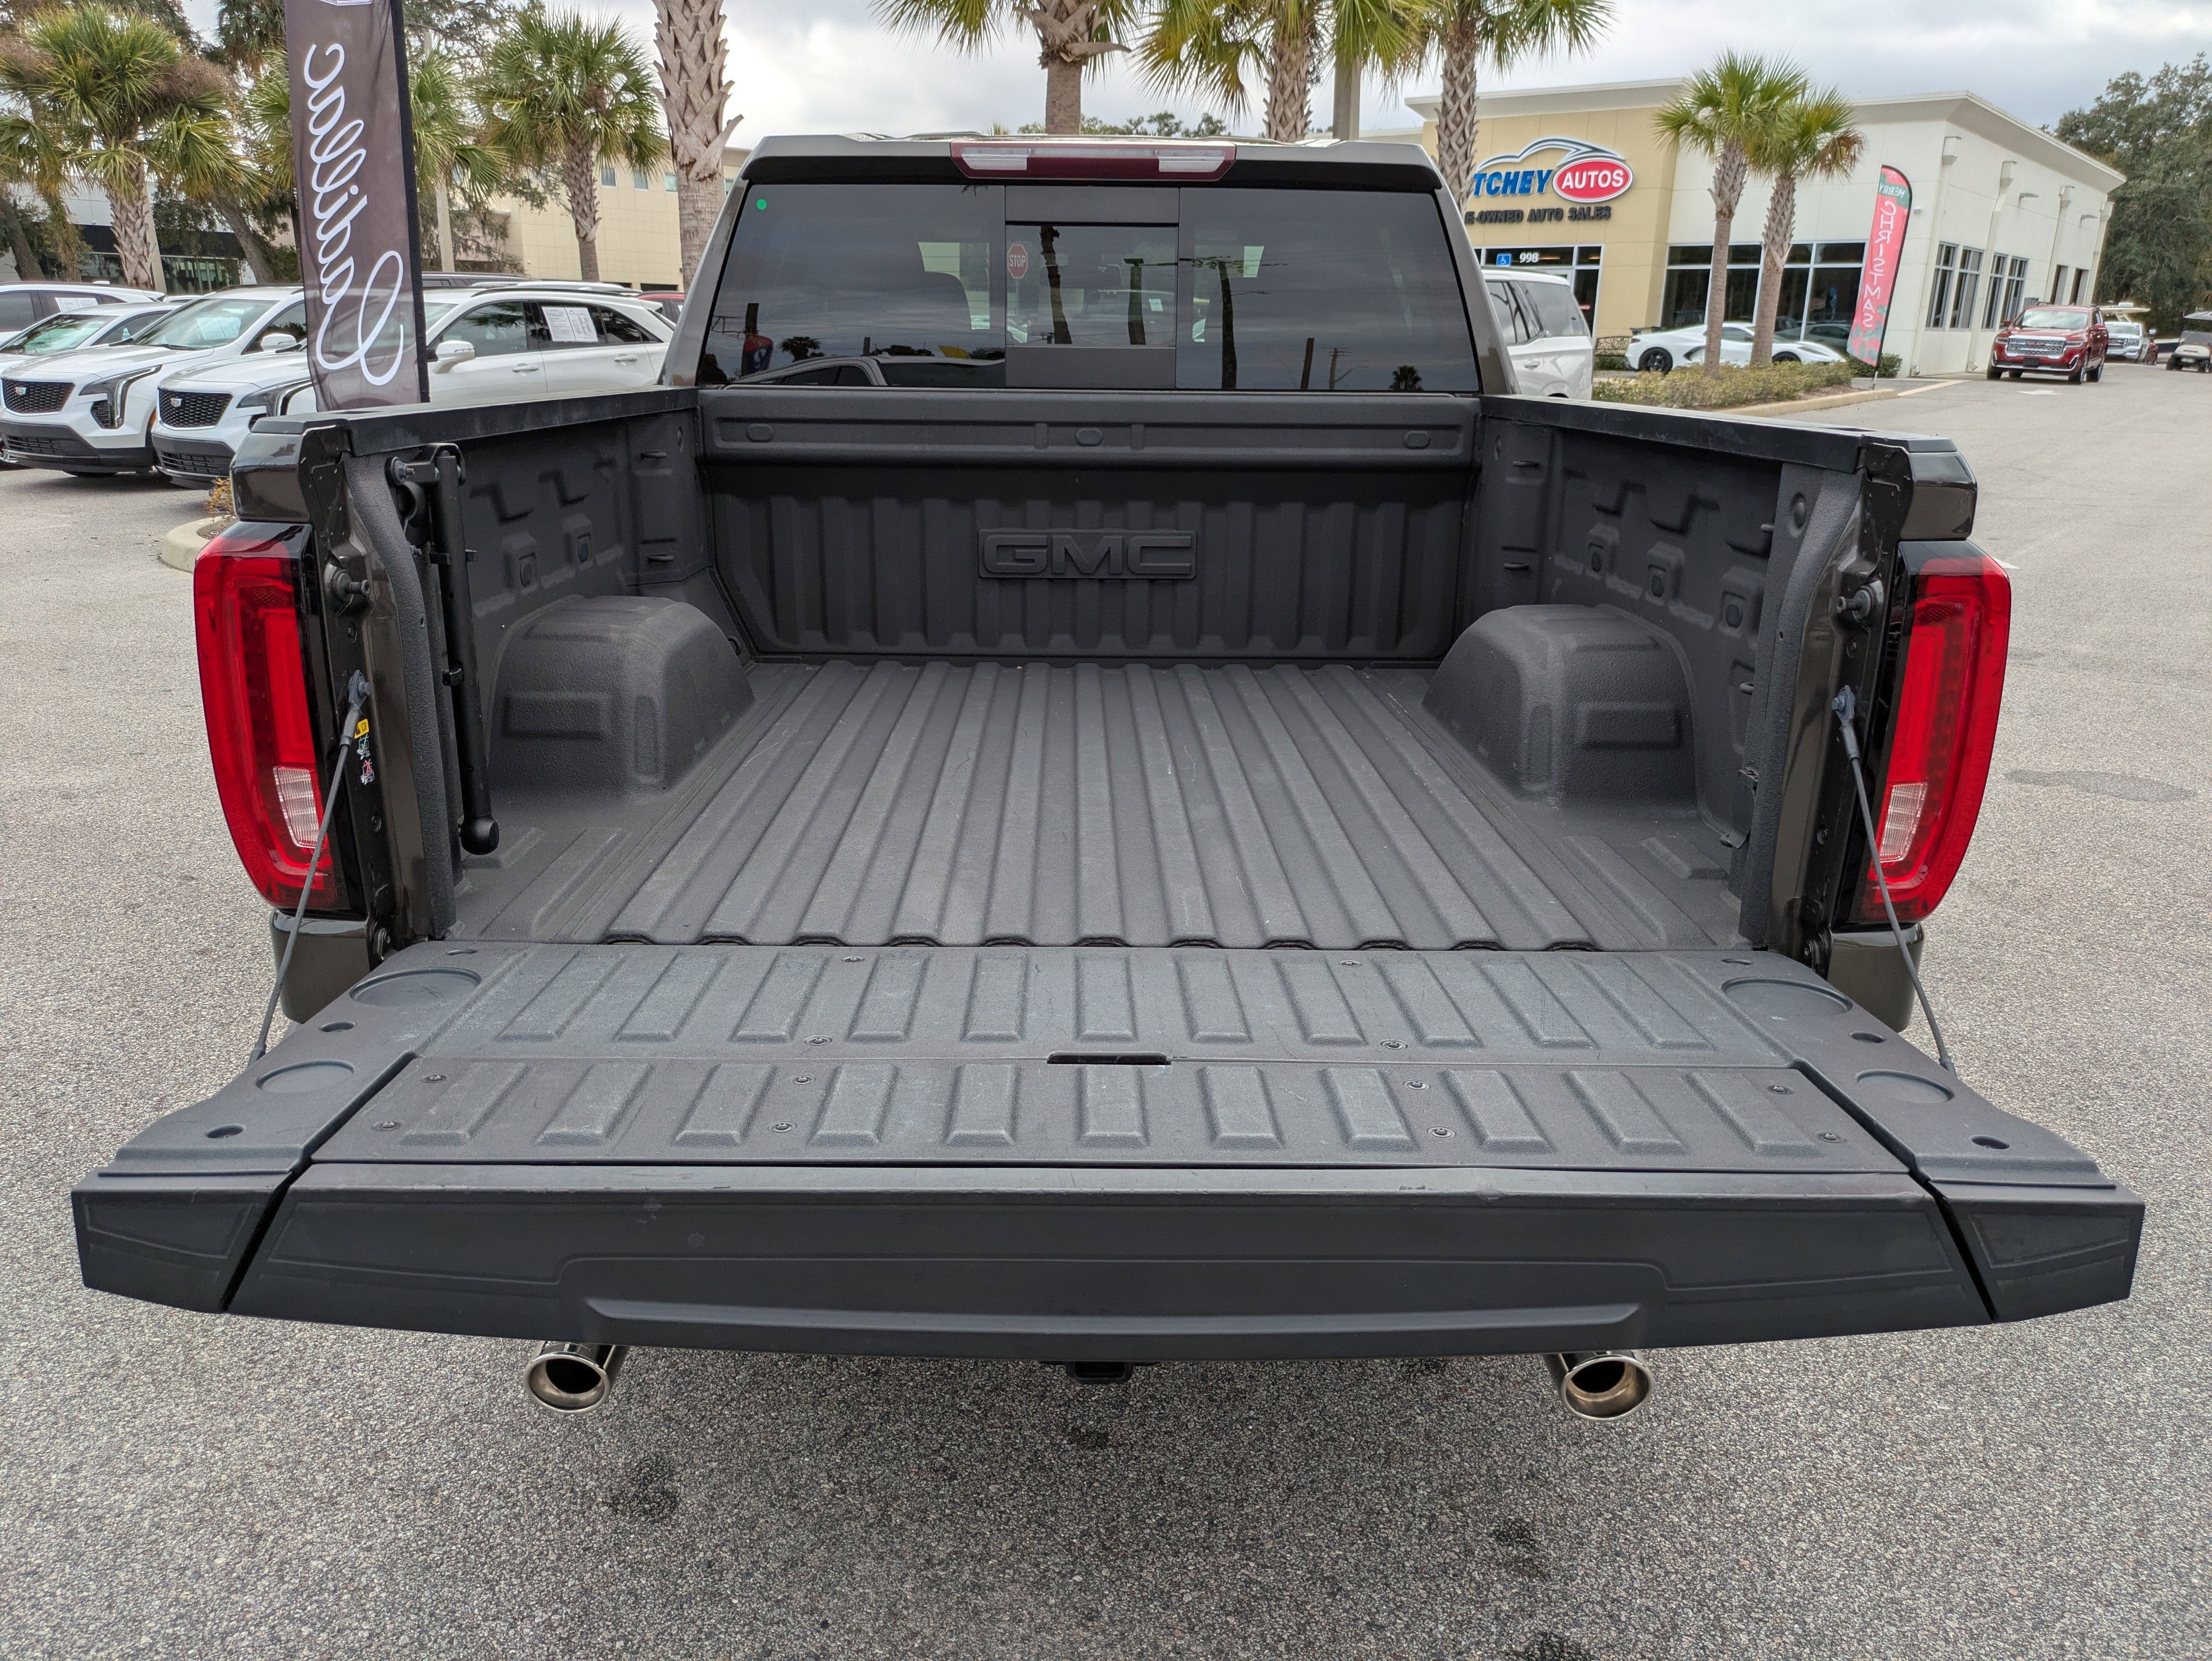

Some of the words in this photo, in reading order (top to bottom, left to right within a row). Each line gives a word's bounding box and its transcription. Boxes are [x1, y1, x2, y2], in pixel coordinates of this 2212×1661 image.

[1561, 170, 1624, 189] AUTOS
[1526, 207, 1564, 222] AUTO
[1568, 206, 1611, 221] SALES
[1009, 255, 1027, 267] STOP
[1519, 252, 1539, 263] 998
[984, 534, 1192, 574] GMC
